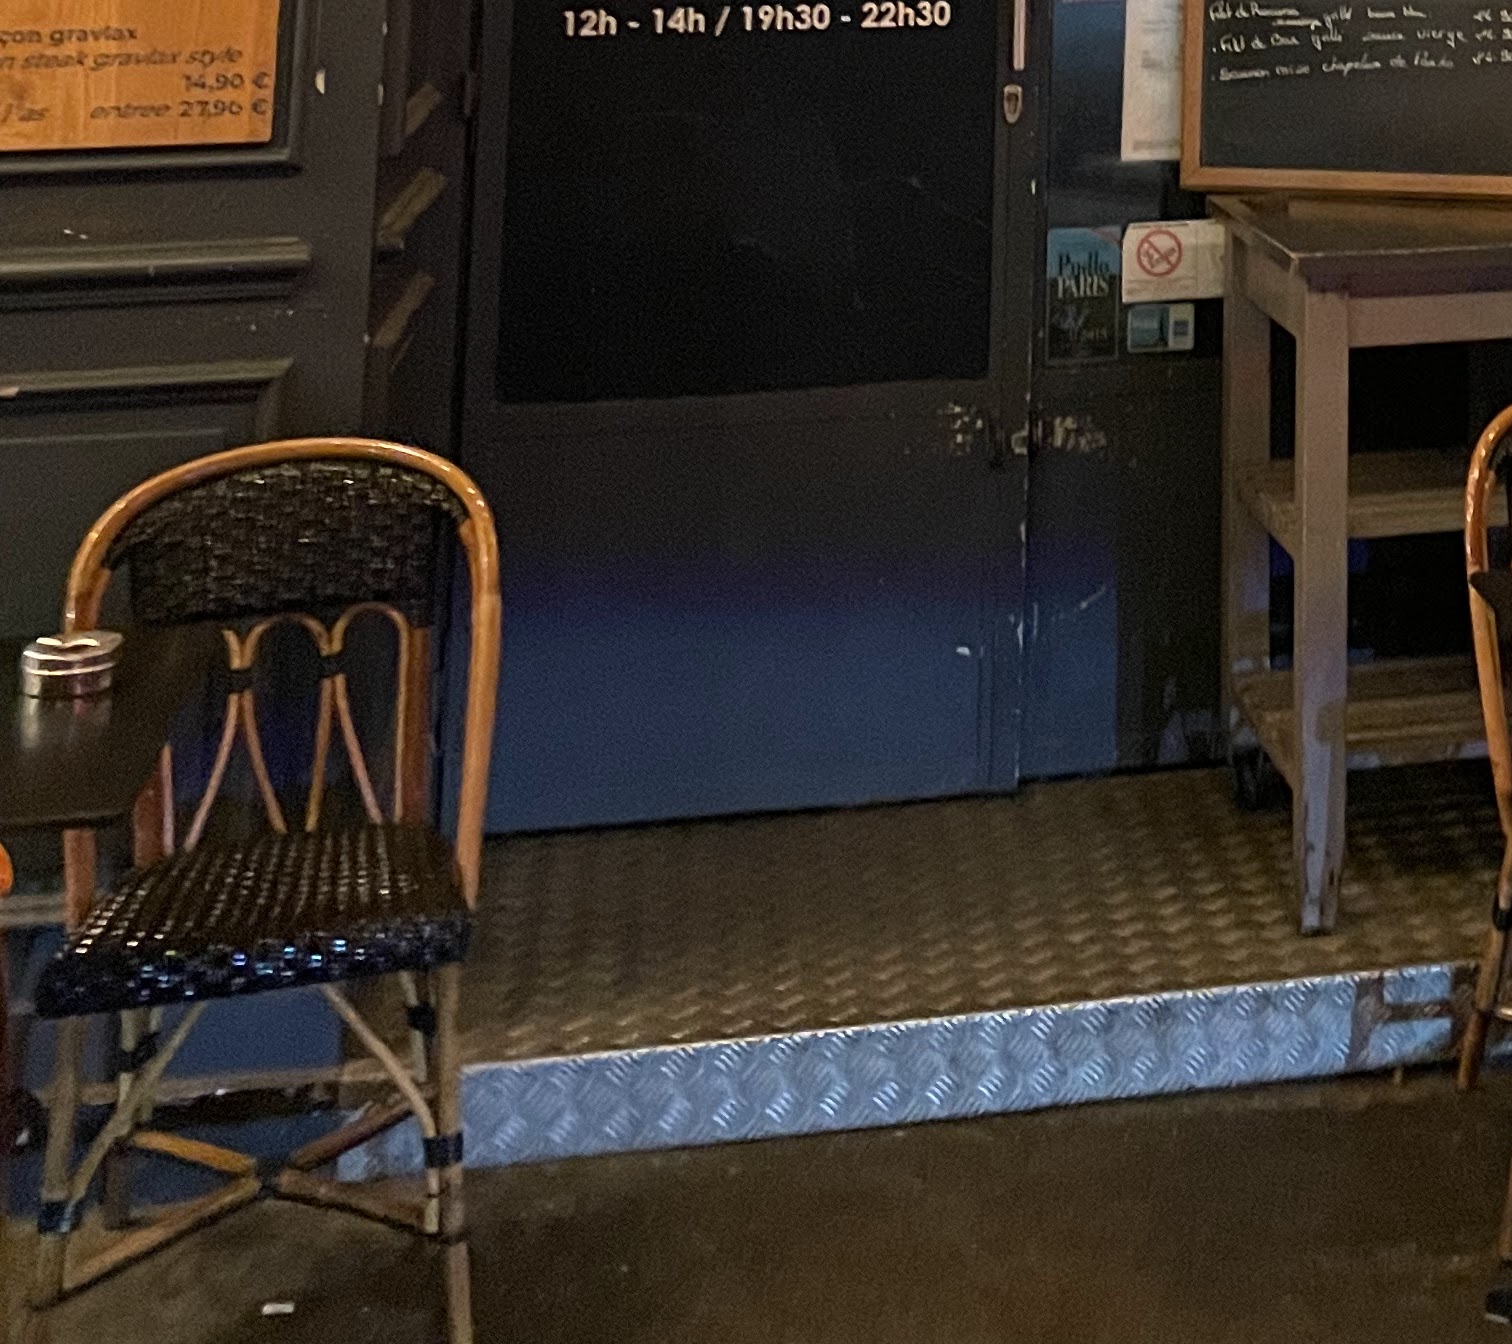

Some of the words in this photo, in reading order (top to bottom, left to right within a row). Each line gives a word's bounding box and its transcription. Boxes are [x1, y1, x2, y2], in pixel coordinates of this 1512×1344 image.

[563, 9, 617, 36] 12h
[652, 6, 706, 34] 14h
[742, 3, 832, 32] 19h30
[861, 0, 952, 29] 22h30
[1057, 273, 1109, 298] PARIS
